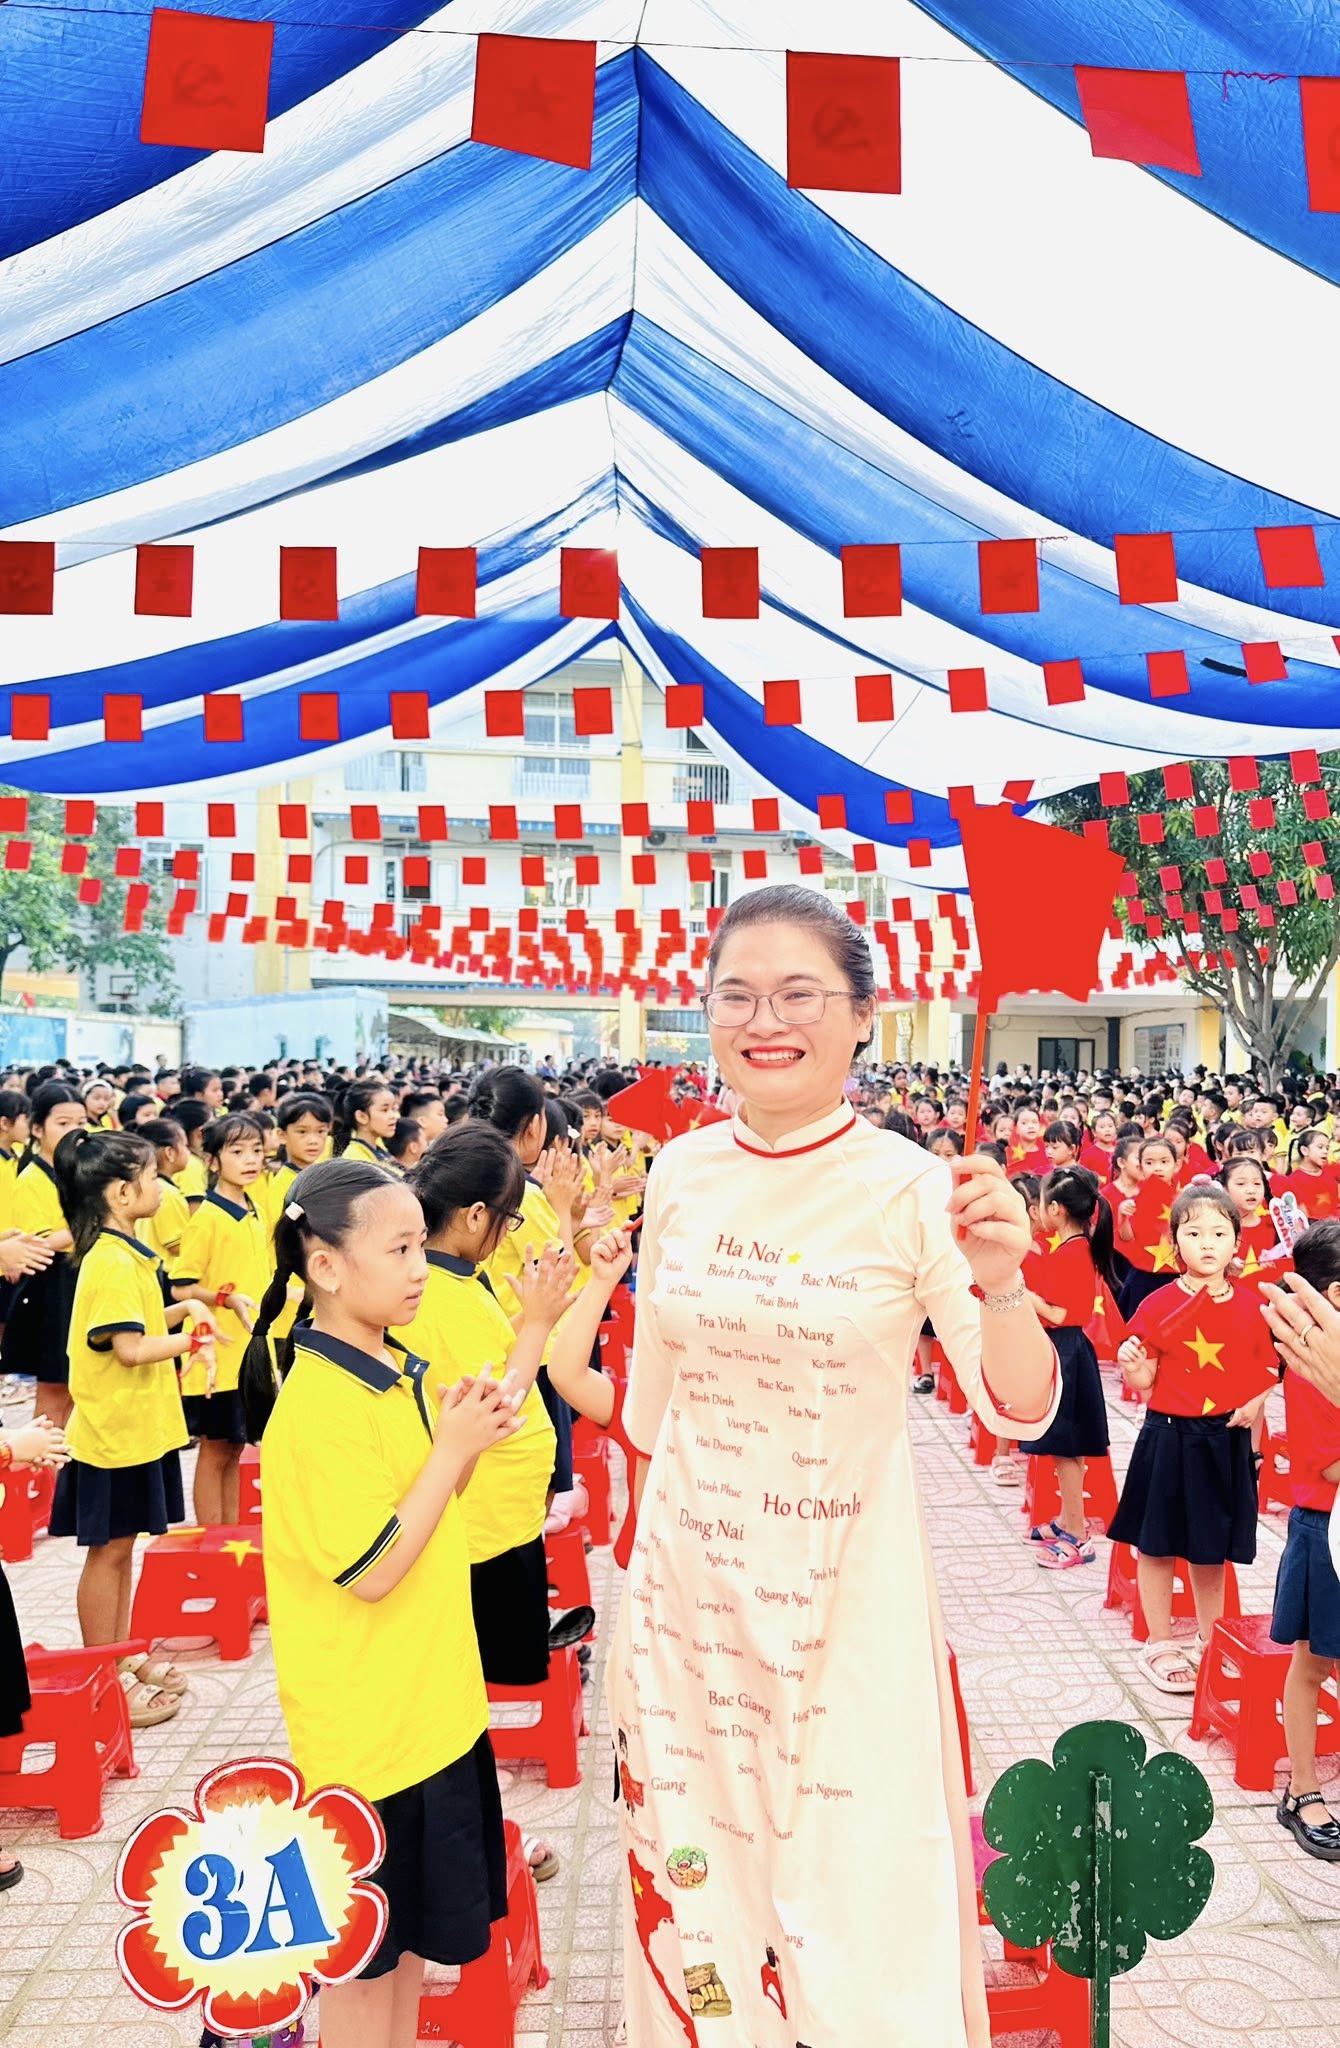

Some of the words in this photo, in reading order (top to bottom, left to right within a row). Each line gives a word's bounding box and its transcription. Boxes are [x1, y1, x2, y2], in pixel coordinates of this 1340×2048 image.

[716, 1234, 743, 1258] Ha
[748, 1241, 784, 1264] Noi
[707, 1263, 735, 1278] Binh
[738, 1268, 778, 1287] Duong
[801, 1273, 824, 1287] Bac
[826, 1274, 858, 1292] Ninh
[755, 1294, 775, 1307] Thai
[777, 1296, 799, 1310] Binh
[696, 1313, 716, 1329] Tra
[717, 1315, 747, 1333] Vinh
[777, 1323, 795, 1339] Da
[798, 1326, 834, 1346] Nang
[707, 1345, 732, 1359] Thua
[733, 1349, 760, 1362] Thien
[761, 1352, 782, 1365] Hue
[825, 1359, 847, 1369] Tum
[706, 1370, 719, 1382] Tri
[757, 1377, 774, 1389] Bac
[775, 1380, 795, 1393] Kan
[689, 1391, 710, 1404] Binh
[711, 1393, 735, 1407] Dinh
[839, 1384, 857, 1395] Tho
[788, 1405, 803, 1418] Ha
[726, 1417, 751, 1433] Vung
[752, 1419, 769, 1434] Tau
[695, 1435, 711, 1448] Hai
[713, 1438, 743, 1457] Duong
[696, 1479, 718, 1494] Vinh
[720, 1483, 742, 1498] Phuc
[763, 1492, 791, 1516] Ho
[679, 1508, 712, 1541] Dong
[716, 1519, 744, 1541] Nai
[705, 1551, 729, 1569] Nghe
[730, 1555, 745, 1569] An
[755, 1586, 789, 1606] Quang
[696, 1597, 721, 1615] Long
[721, 1601, 735, 1615] An
[780, 1665, 806, 1682] Long
[708, 1690, 734, 1706] Bac
[738, 1692, 772, 1725] Giang
[705, 1720, 728, 1738] Lam
[650, 1776, 687, 1796] Giang
[815, 1782, 853, 1801] Nguyen
[182, 1837, 336, 1961] 3A
[677, 1927, 695, 1940] Lao
[696, 1930, 713, 1944] Cai
